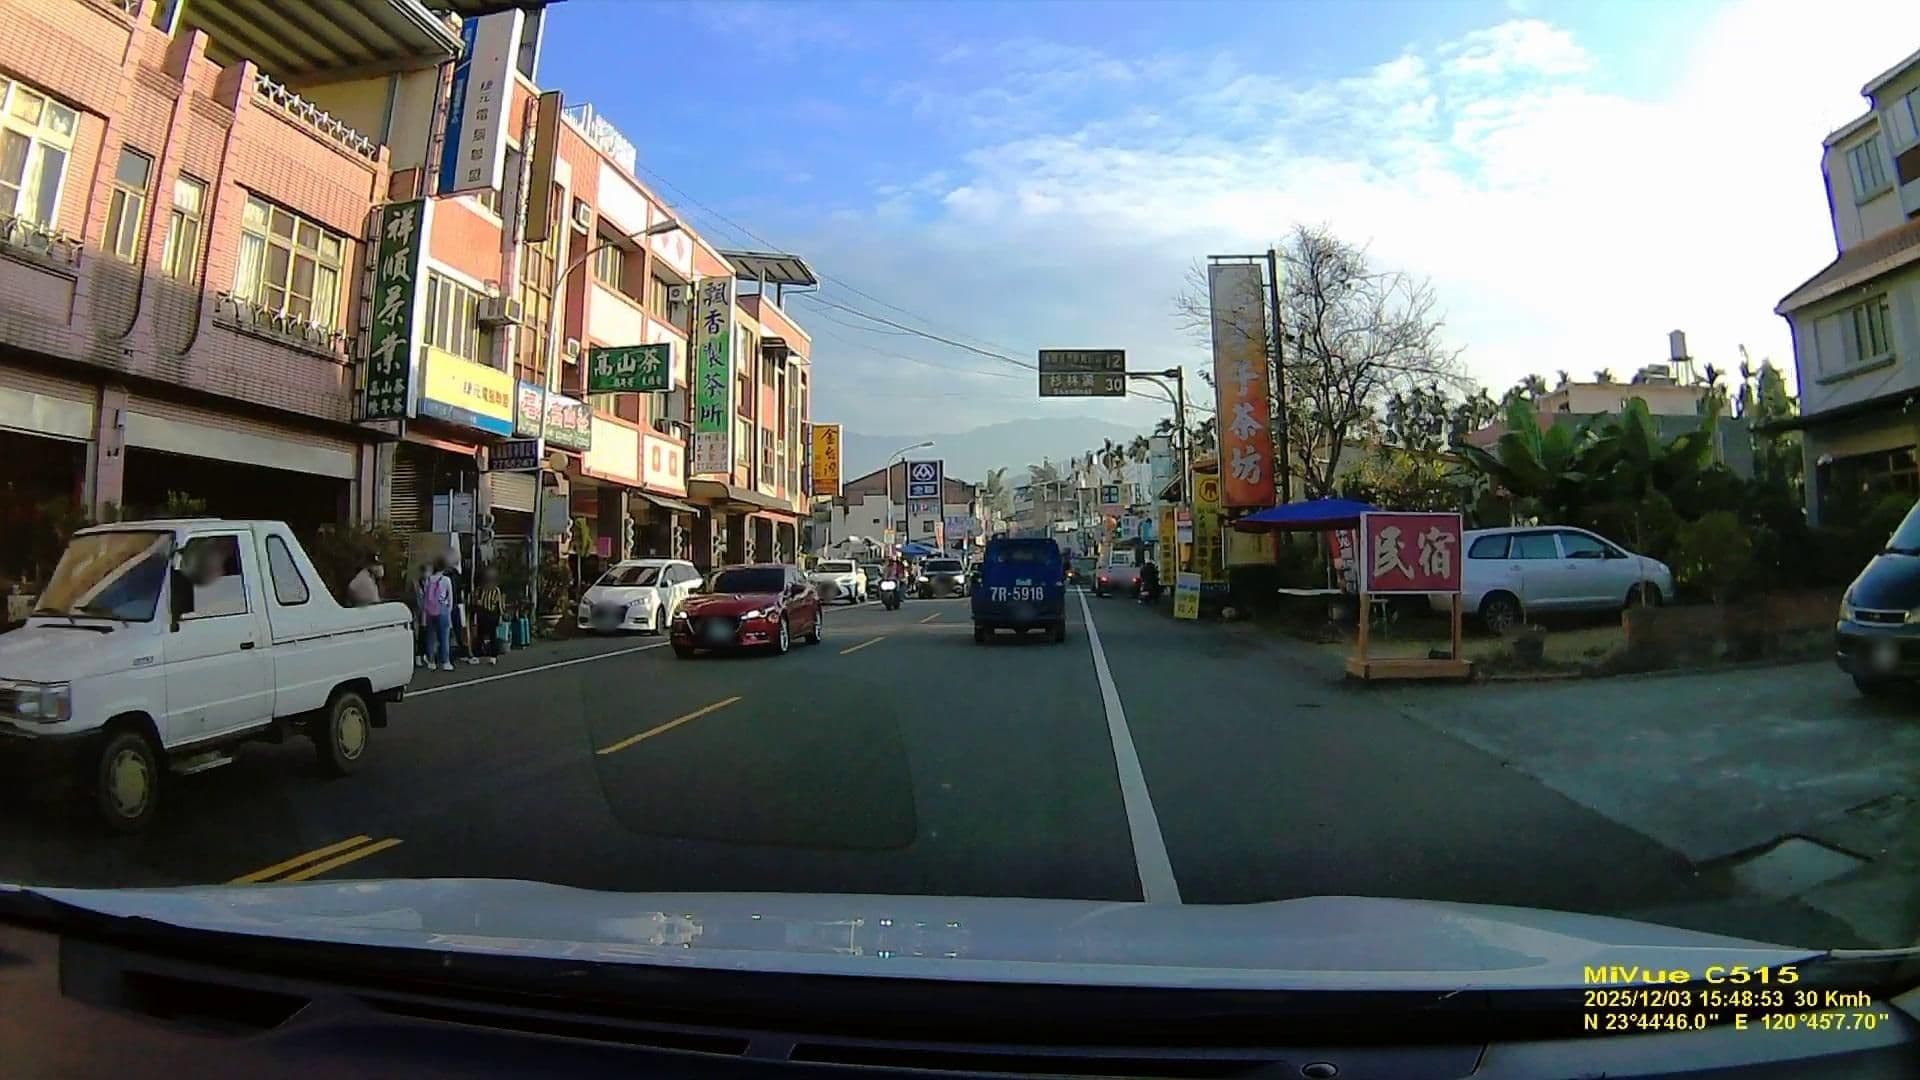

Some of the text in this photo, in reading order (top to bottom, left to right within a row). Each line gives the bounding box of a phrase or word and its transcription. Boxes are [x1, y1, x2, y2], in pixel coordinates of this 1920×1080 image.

[593, 347, 662, 378] 高山茶
[699, 281, 729, 427] 飄香製茶所
[1105, 378, 1123, 392] 30
[1374, 525, 1456, 580] 民宿
